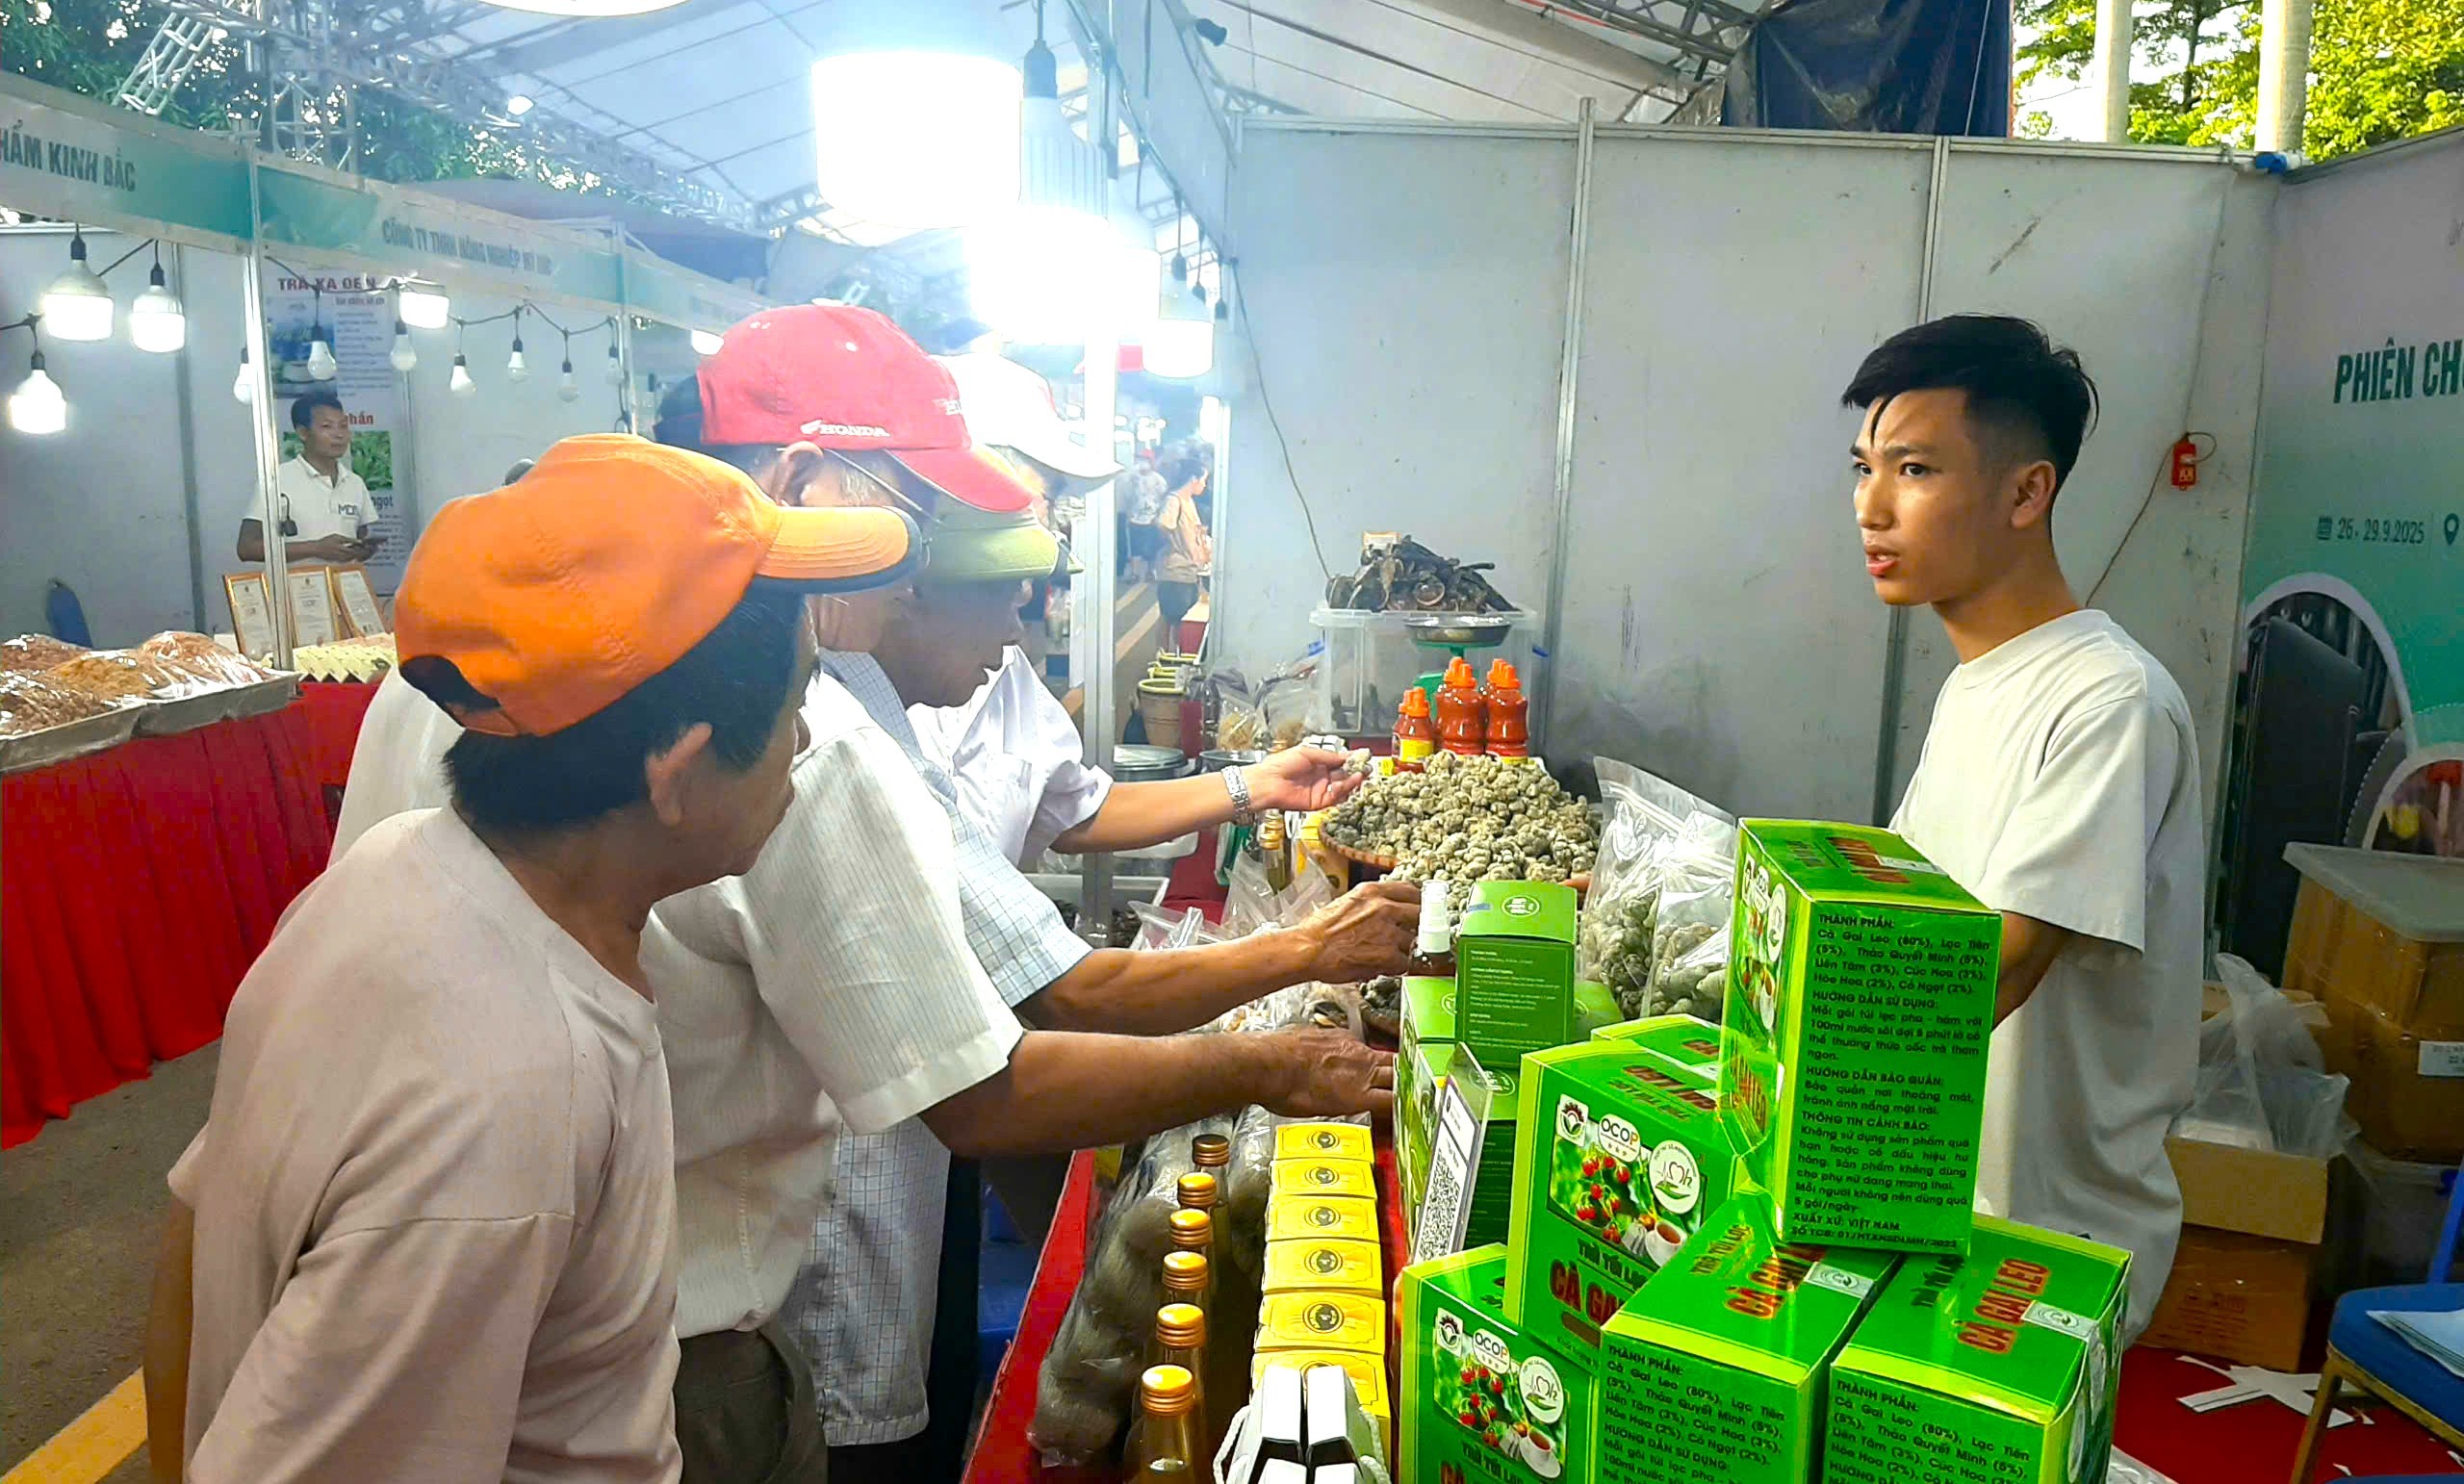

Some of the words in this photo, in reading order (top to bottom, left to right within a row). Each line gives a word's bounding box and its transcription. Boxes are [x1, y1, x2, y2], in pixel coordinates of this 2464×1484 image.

[49, 142, 97, 183] KINH
[2333, 337, 2416, 403] PHIÊN
[2423, 339, 2464, 397] CH
[819, 423, 890, 438] HONDA
[1601, 1117, 1639, 1145] OCOP
[1953, 1319, 2017, 1354] CÀ
[1991, 1258, 2049, 1295] LEO
[1475, 1332, 1508, 1359] OCOP
